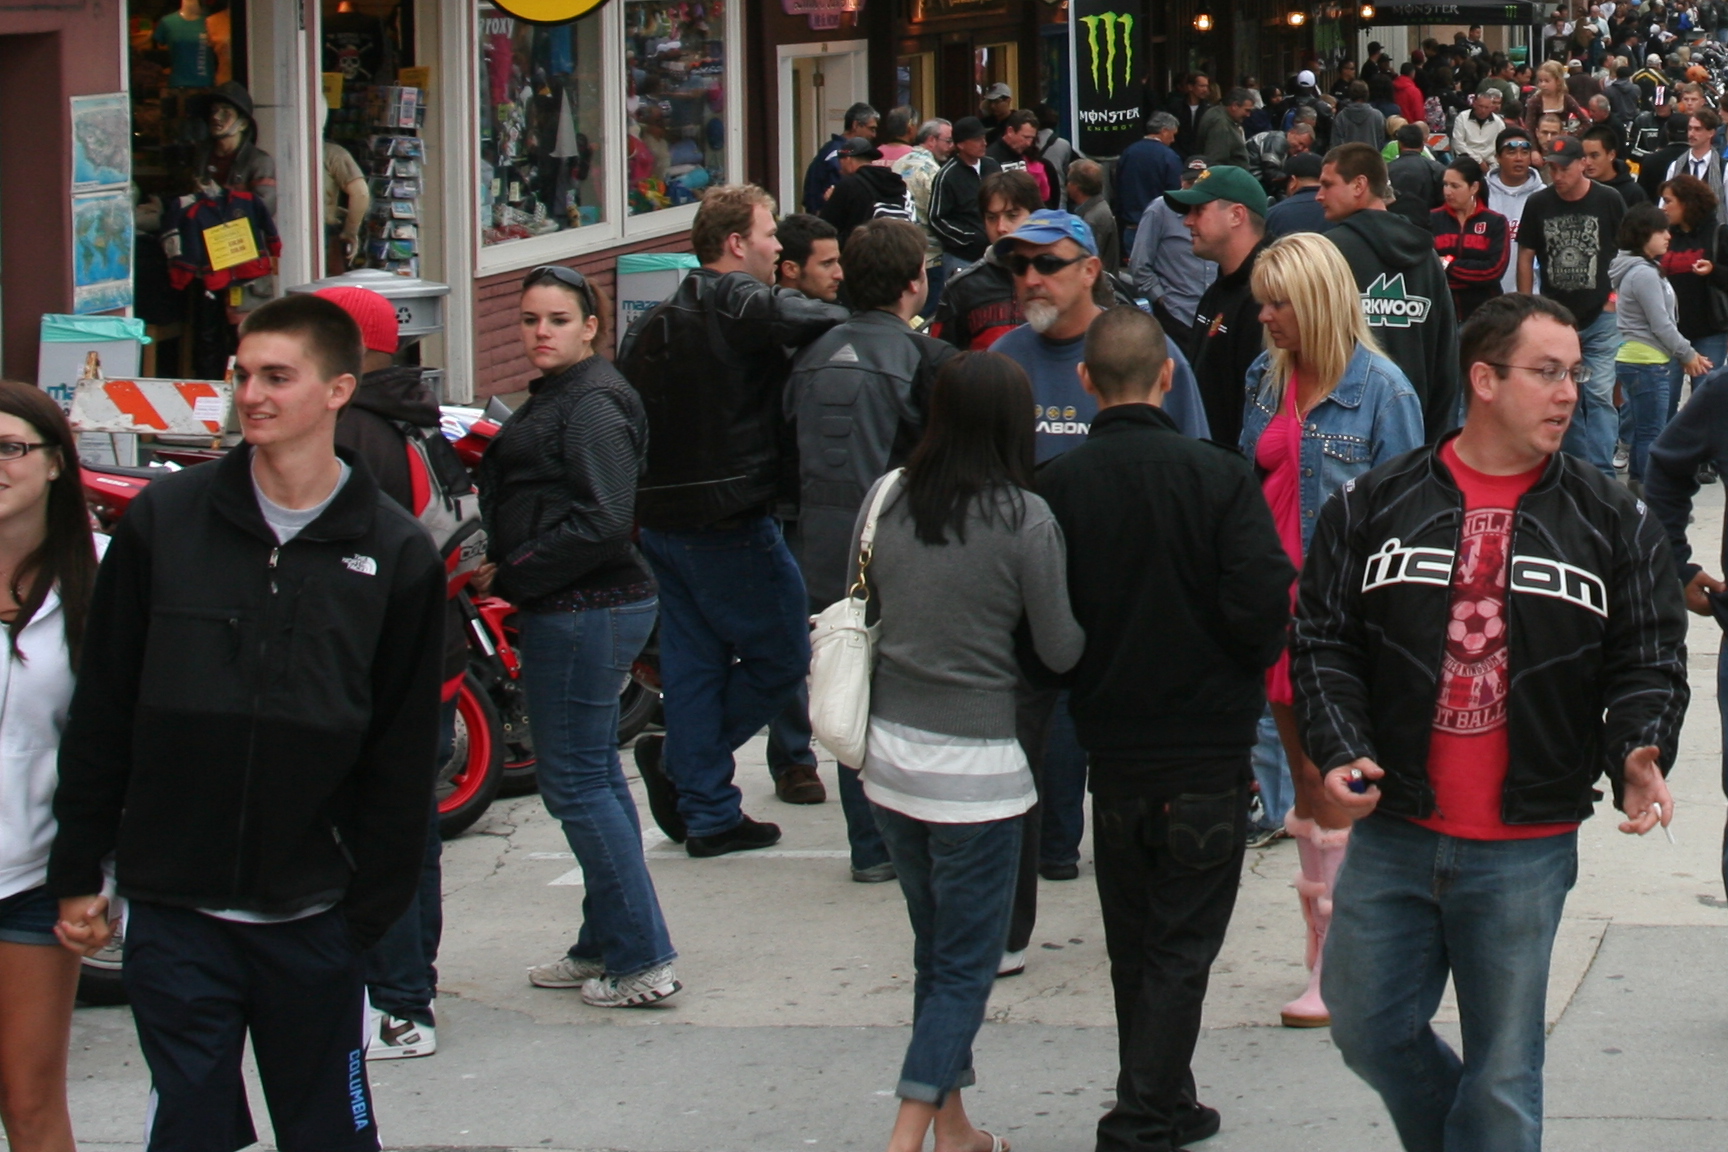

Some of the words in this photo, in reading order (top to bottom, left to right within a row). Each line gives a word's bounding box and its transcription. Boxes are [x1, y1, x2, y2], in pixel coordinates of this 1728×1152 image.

[1393, 4, 1460, 15] MONSTER
[1079, 107, 1140, 124] MONSTER
[1362, 298, 1424, 317] RKWOOD
[348, 1049, 369, 1133] COLUMBIA
